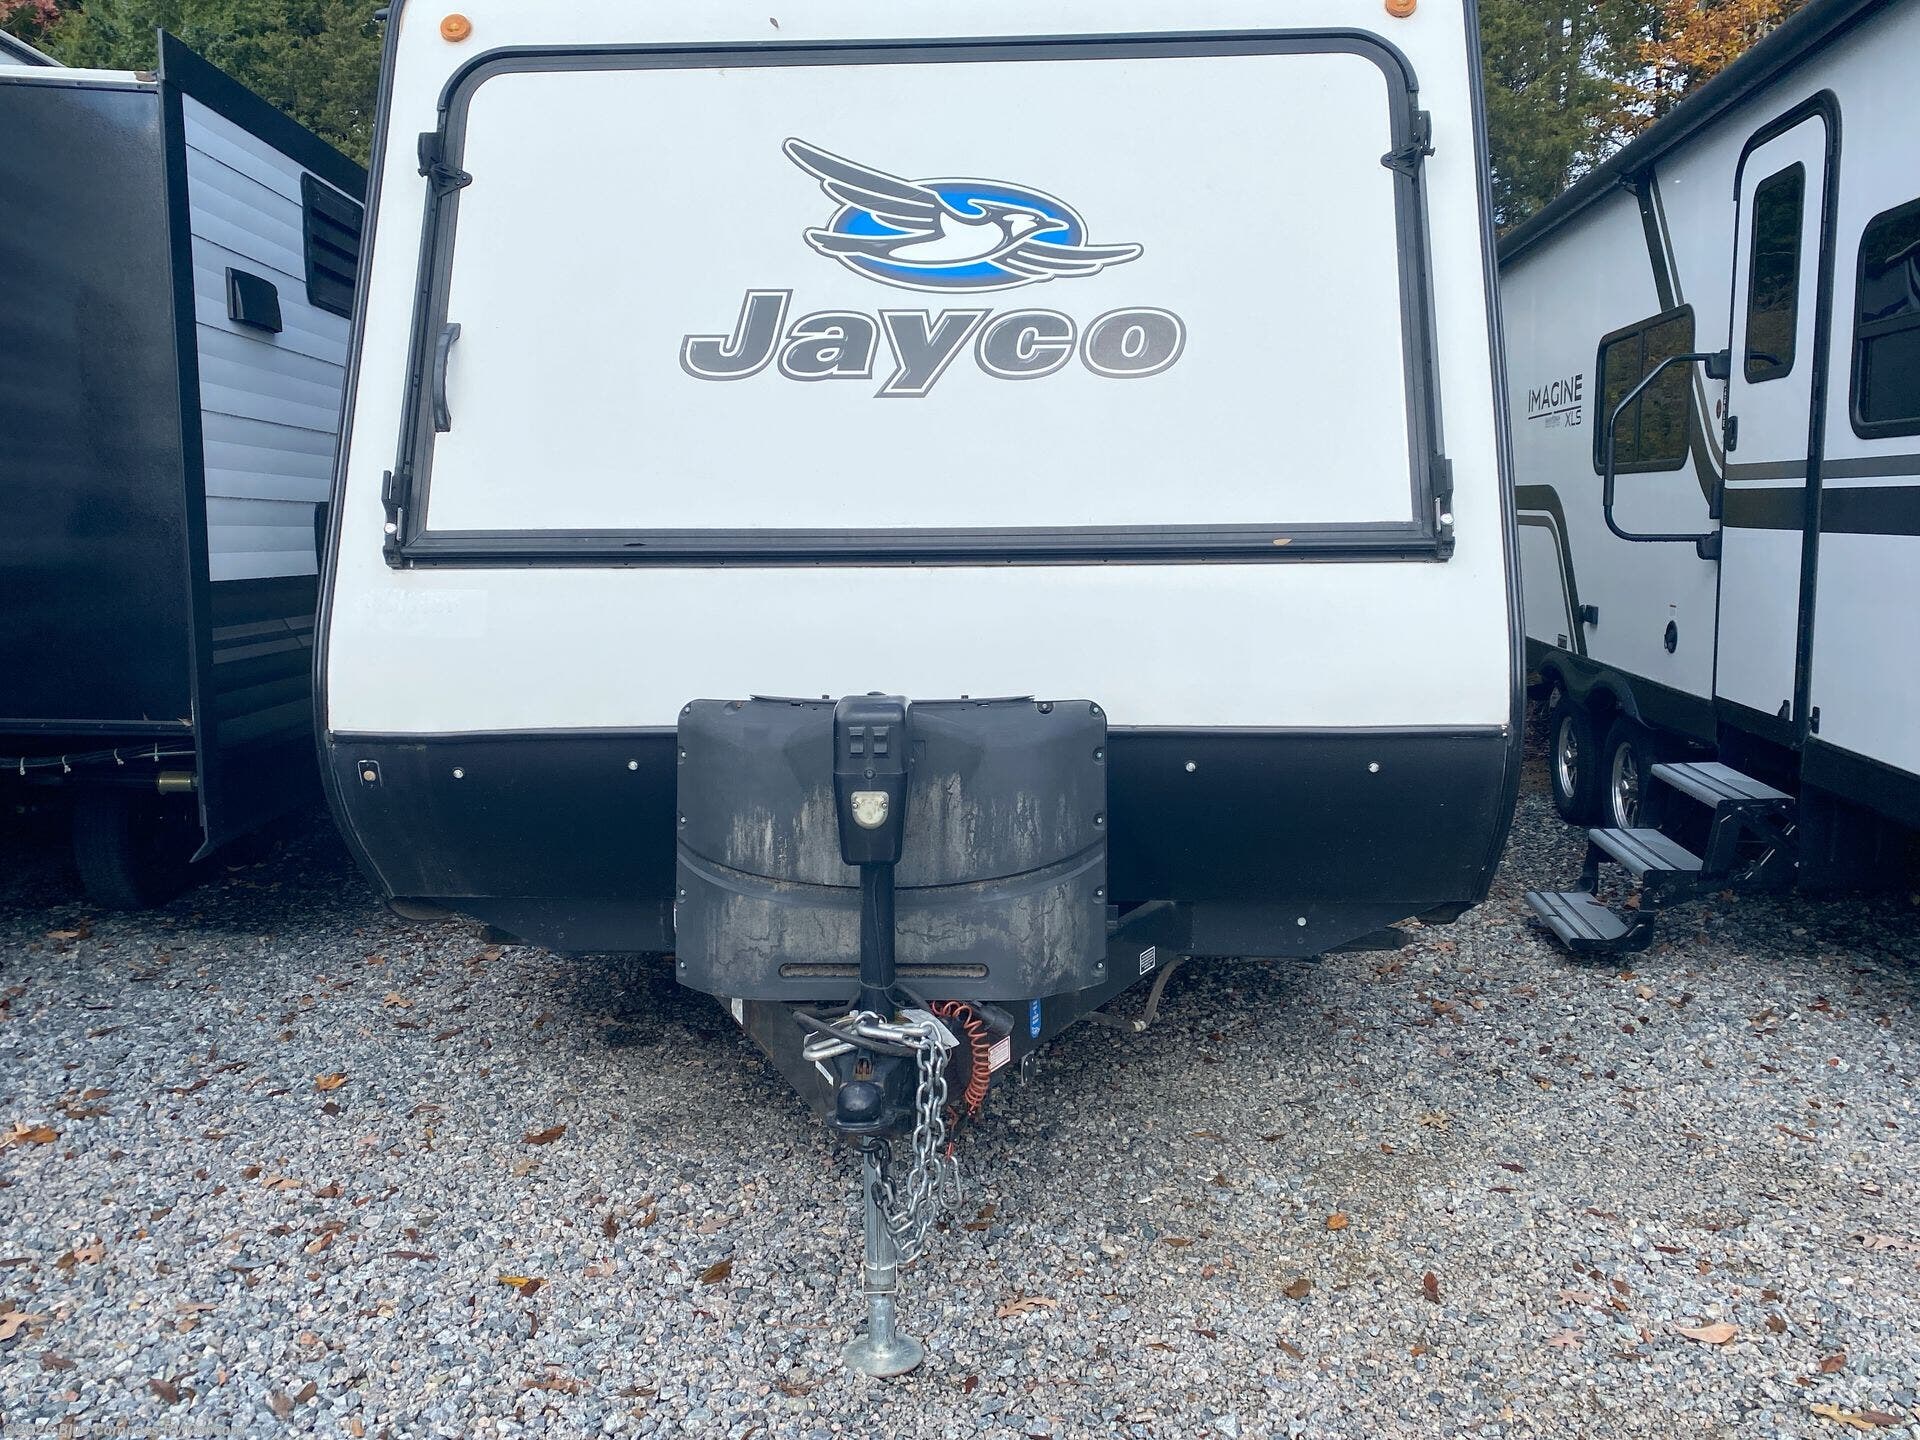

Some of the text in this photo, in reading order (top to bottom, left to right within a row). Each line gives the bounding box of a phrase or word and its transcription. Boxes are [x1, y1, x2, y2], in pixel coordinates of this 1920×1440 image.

[679, 288, 1187, 398] Jayco
[1528, 373, 1583, 413] IMAGINE
[1564, 409, 1582, 428] XLS
